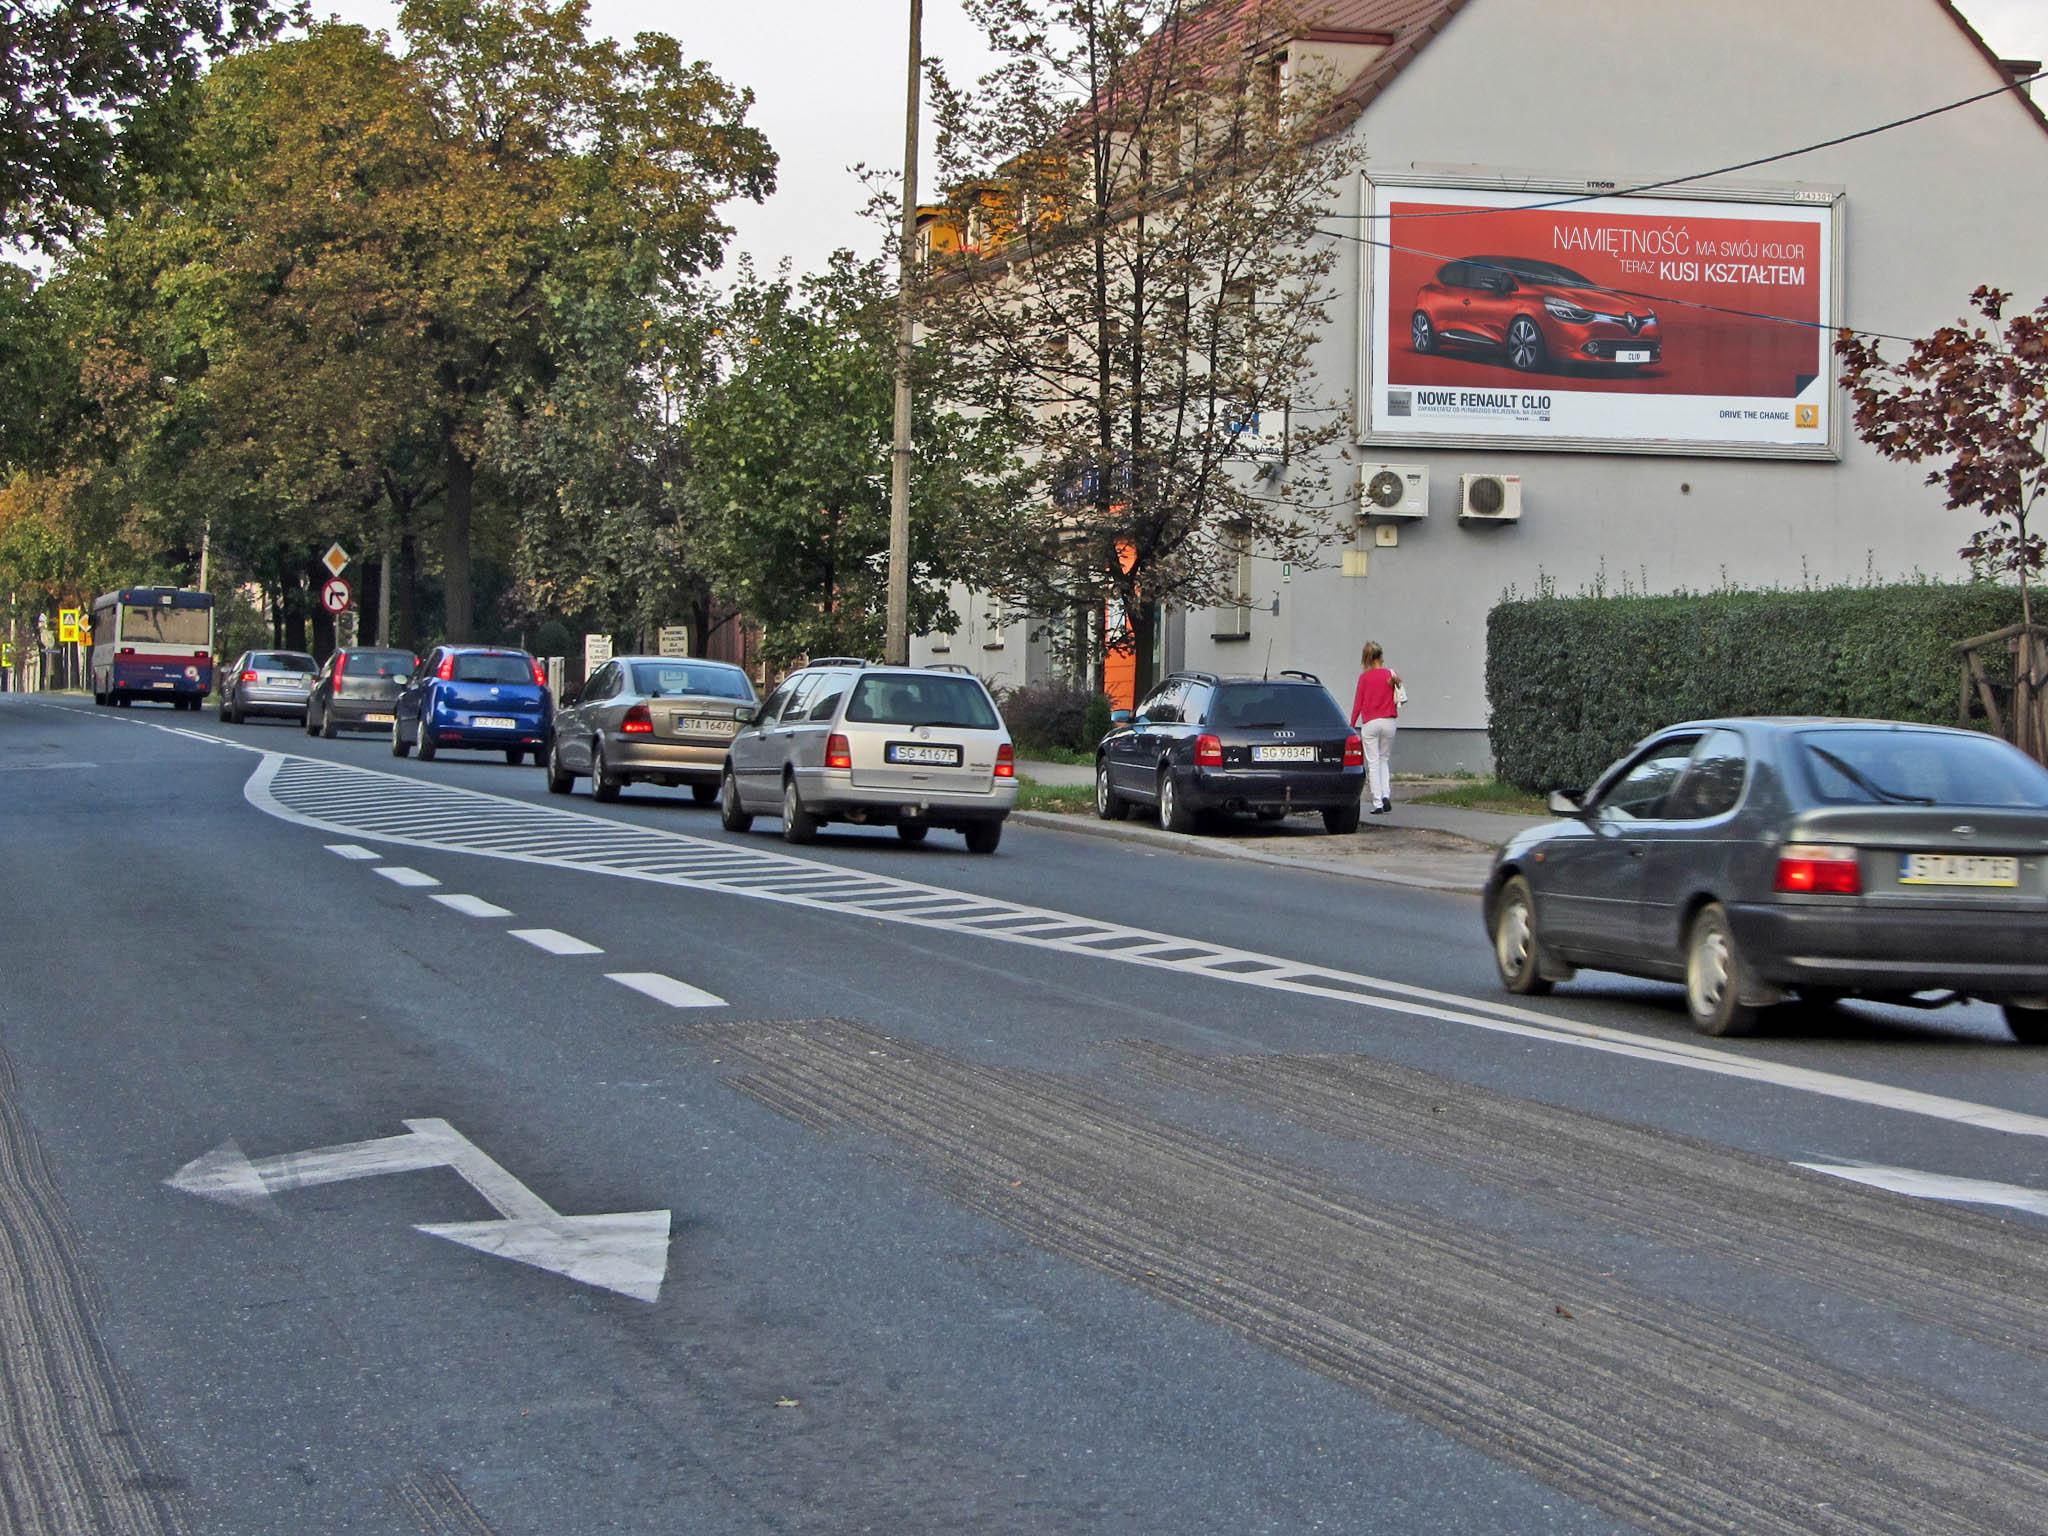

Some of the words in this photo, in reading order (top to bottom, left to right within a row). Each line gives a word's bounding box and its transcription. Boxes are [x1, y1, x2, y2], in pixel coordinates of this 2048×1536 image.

[1553, 225, 1690, 258] NAMIĘTNOŚĆ
[1696, 241, 1717, 256] MA
[1721, 239, 1758, 259] SWÓJ
[1762, 243, 1805, 260] KOLOR
[1620, 259, 1655, 274] TERAZ
[1660, 261, 1699, 281] KUSI
[1704, 263, 1805, 286] KSZTAŁTEM
[1417, 391, 1457, 406] NOWE
[1460, 393, 1518, 408] RENAULT
[1521, 395, 1551, 410] CLIO
[1719, 410, 1742, 419] DRIVE
[1744, 410, 1758, 419] THE
[1759, 411, 1790, 420] CHANGE
[683, 719, 702, 729] STA
[705, 721, 732, 732] 16476
[898, 747, 916, 759] SG
[919, 748, 956, 761] 4167F
[1261, 747, 1277, 757] SG
[1280, 748, 1312, 759] 9834F
